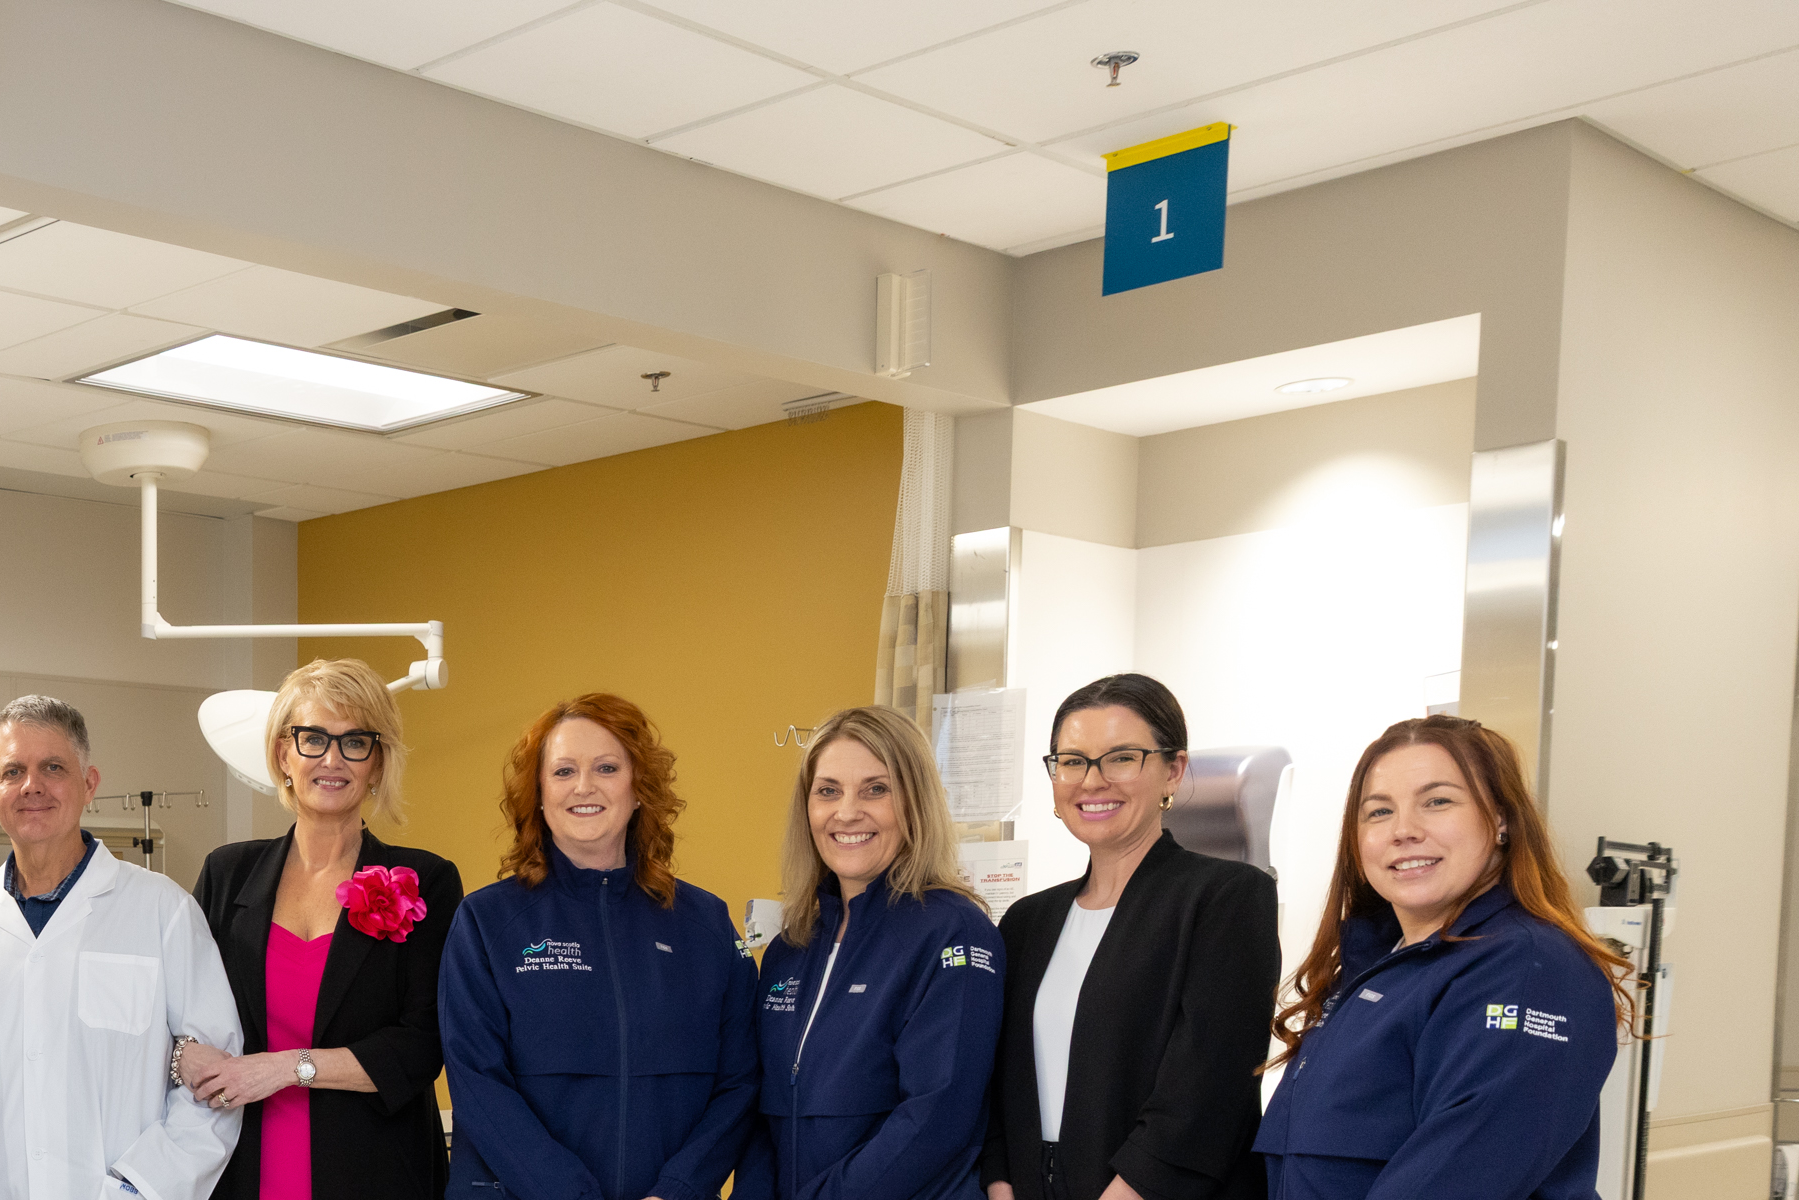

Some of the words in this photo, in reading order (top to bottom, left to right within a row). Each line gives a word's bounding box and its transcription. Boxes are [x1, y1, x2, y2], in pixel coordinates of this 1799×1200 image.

[1152, 199, 1174, 243] 1
[548, 946, 581, 956] health
[516, 964, 540, 973] Pelvic
[572, 963, 592, 972] Suite
[1525, 1014, 1555, 1026] General
[1526, 1008, 1567, 1022] Dartmouth
[1524, 1020, 1555, 1033] Hospital
[1523, 1027, 1569, 1042] Foundation
